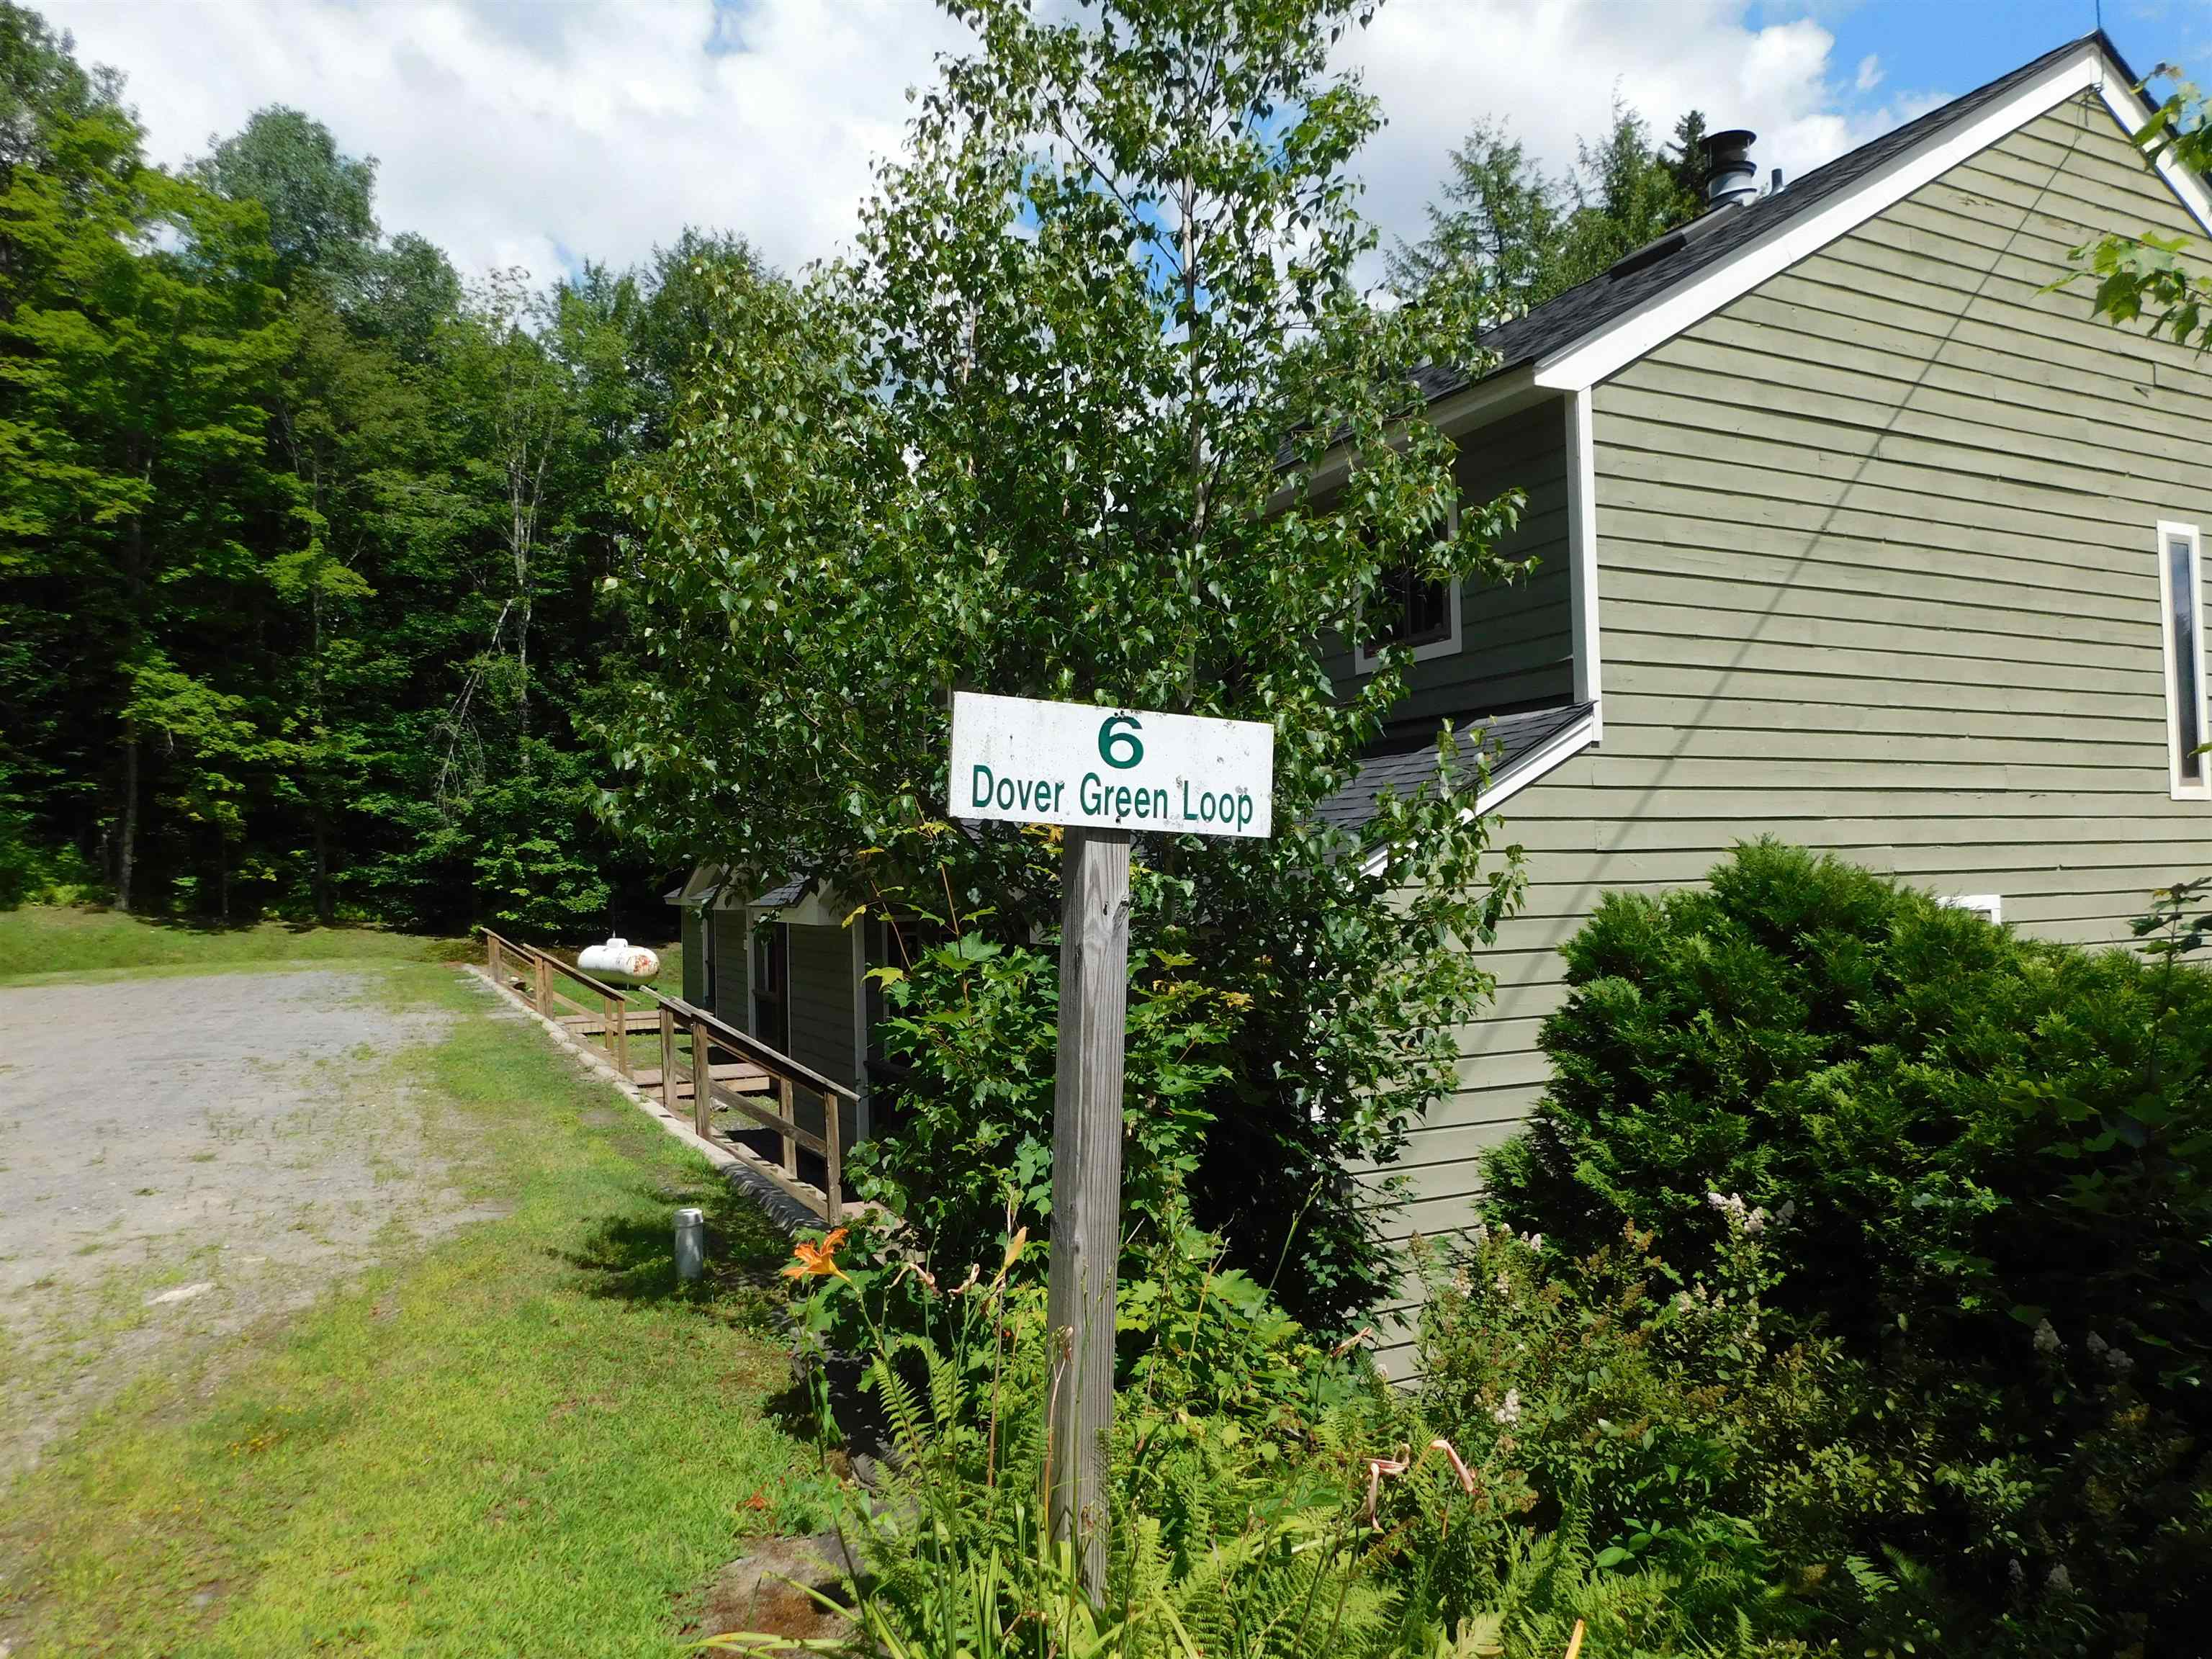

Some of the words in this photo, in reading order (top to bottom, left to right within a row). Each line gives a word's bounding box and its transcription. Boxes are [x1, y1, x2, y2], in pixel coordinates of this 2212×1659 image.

[1097, 715, 1144, 769] 6
[972, 765, 1065, 812] Dover
[1080, 772, 1168, 819] Green
[1183, 780, 1253, 832] Loop
